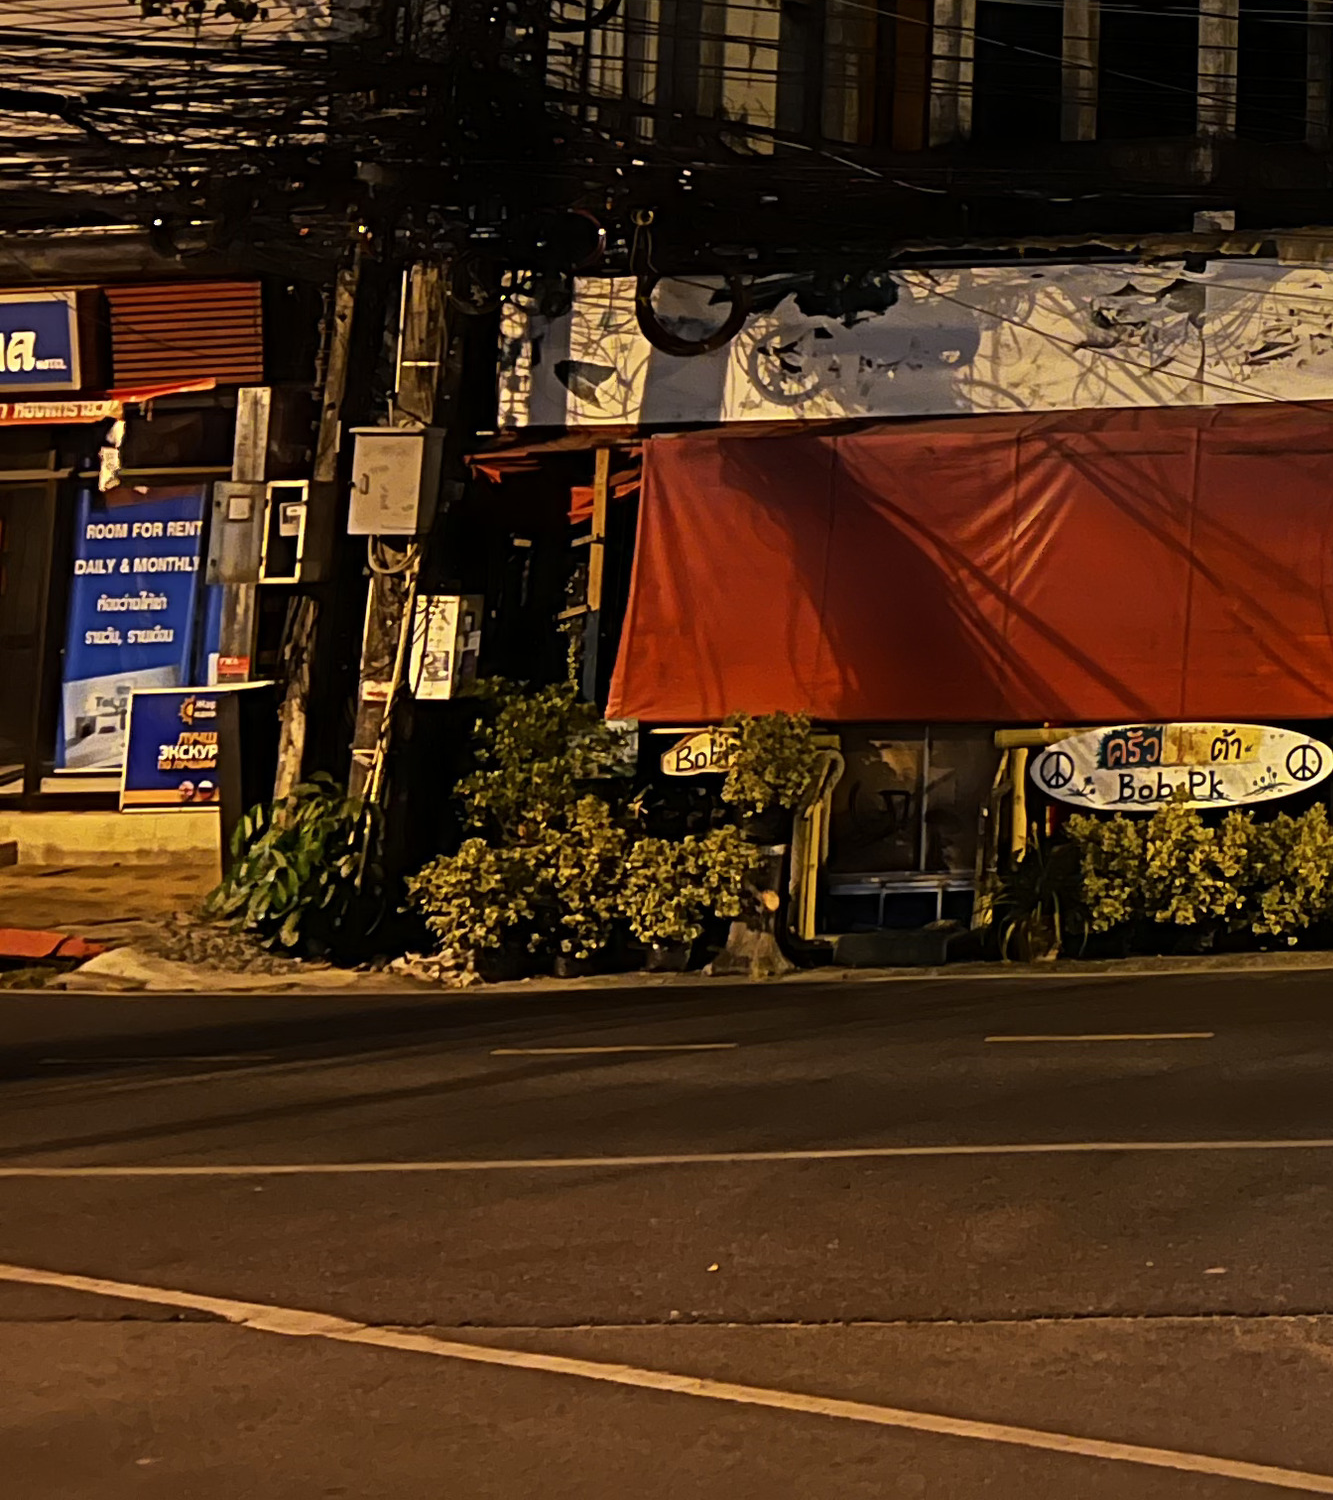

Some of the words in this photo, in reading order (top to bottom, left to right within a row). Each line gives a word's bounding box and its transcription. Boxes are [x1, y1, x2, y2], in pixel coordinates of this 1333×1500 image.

[86, 523, 128, 539] ROOM
[132, 522, 163, 538] FOR
[167, 521, 203, 537] RENT
[74, 558, 116, 575] DAILY
[119, 558, 130, 574] &
[133, 556, 200, 573] MONTHLY
[1106, 730, 1161, 767] ครัว
[1118, 772, 1173, 802] Bob
[1188, 770, 1227, 800] Pk
